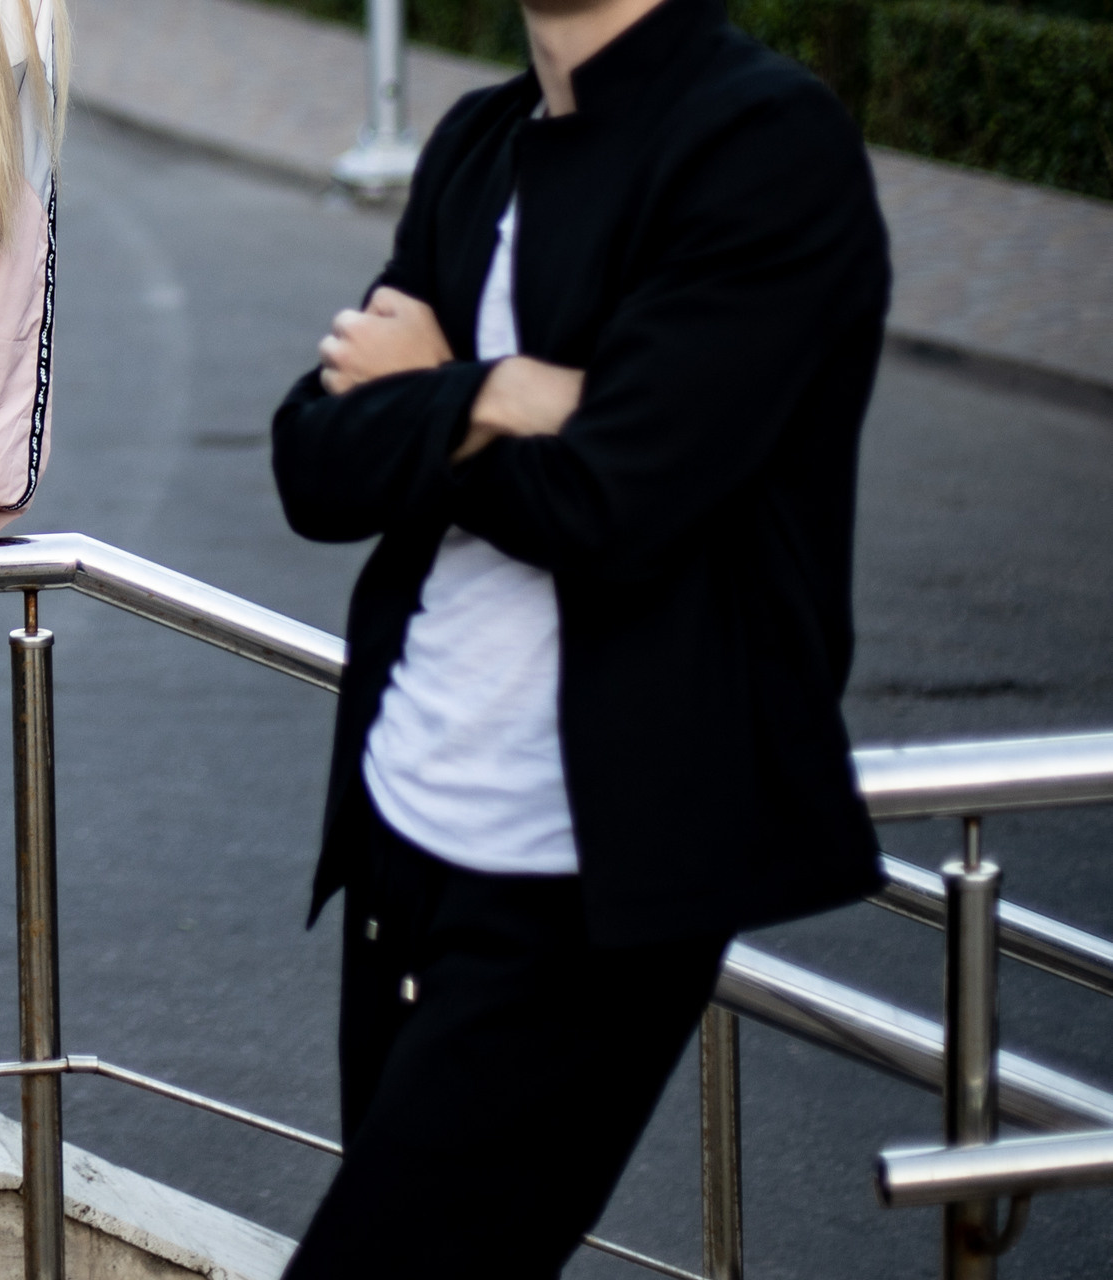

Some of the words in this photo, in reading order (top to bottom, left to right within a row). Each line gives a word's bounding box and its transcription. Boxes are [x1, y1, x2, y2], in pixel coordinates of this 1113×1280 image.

[38, 385, 46, 405] THE
[32, 436, 38, 451] OF
[32, 451, 38, 467] MY
